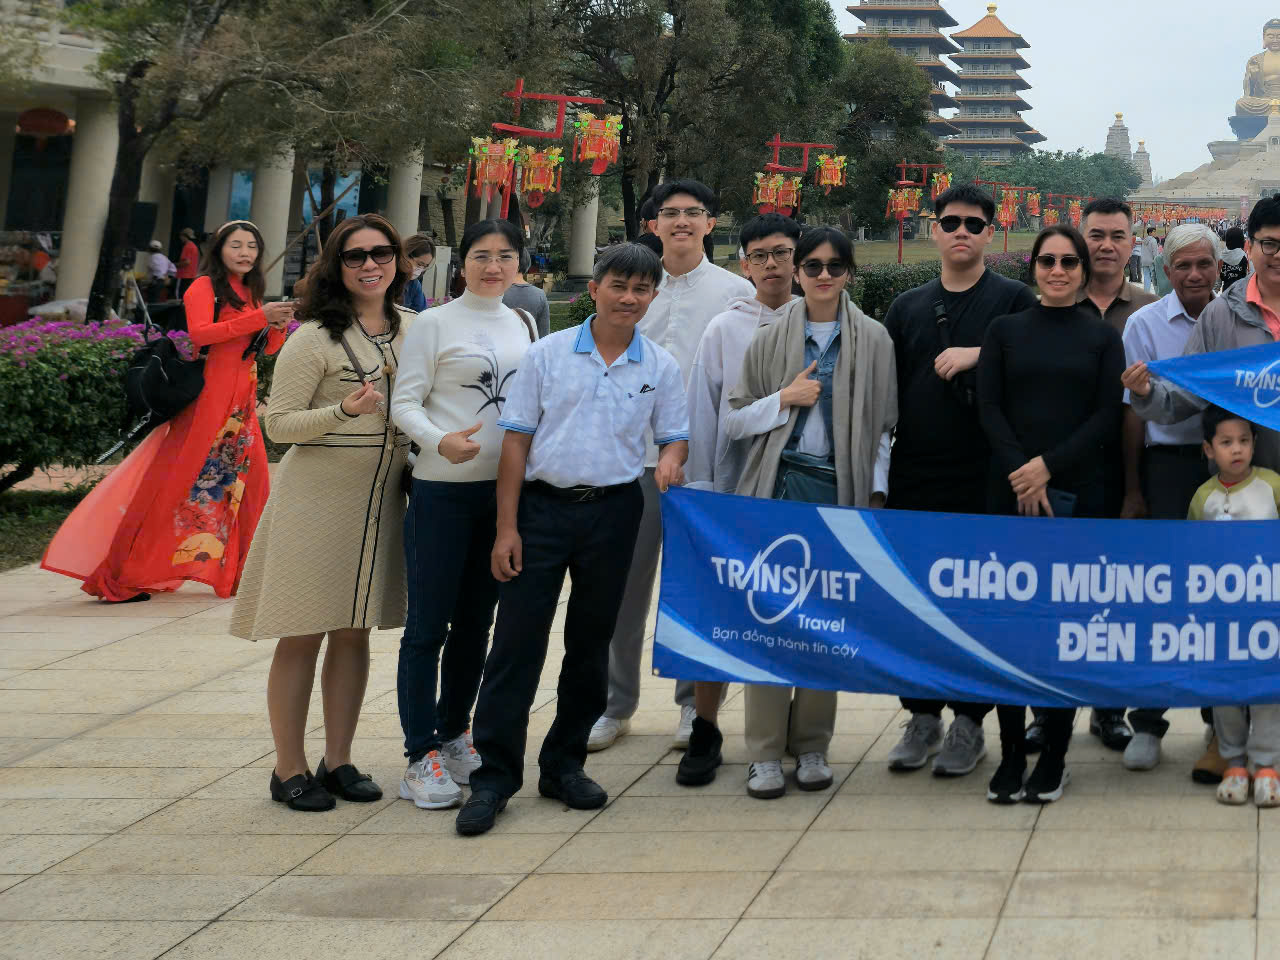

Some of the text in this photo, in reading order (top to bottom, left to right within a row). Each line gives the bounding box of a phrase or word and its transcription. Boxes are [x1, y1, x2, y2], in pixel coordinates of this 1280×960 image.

[711, 549, 861, 607] TRANSVIET
[928, 552, 1038, 601] CHÀO
[1051, 556, 1172, 604] MỪNG
[712, 627, 859, 658] Bạn đồng hành tín cậy
[798, 614, 845, 632] Travel
[1057, 608, 1136, 662] ĐẾN
[1150, 614, 1215, 662] ĐÀI
